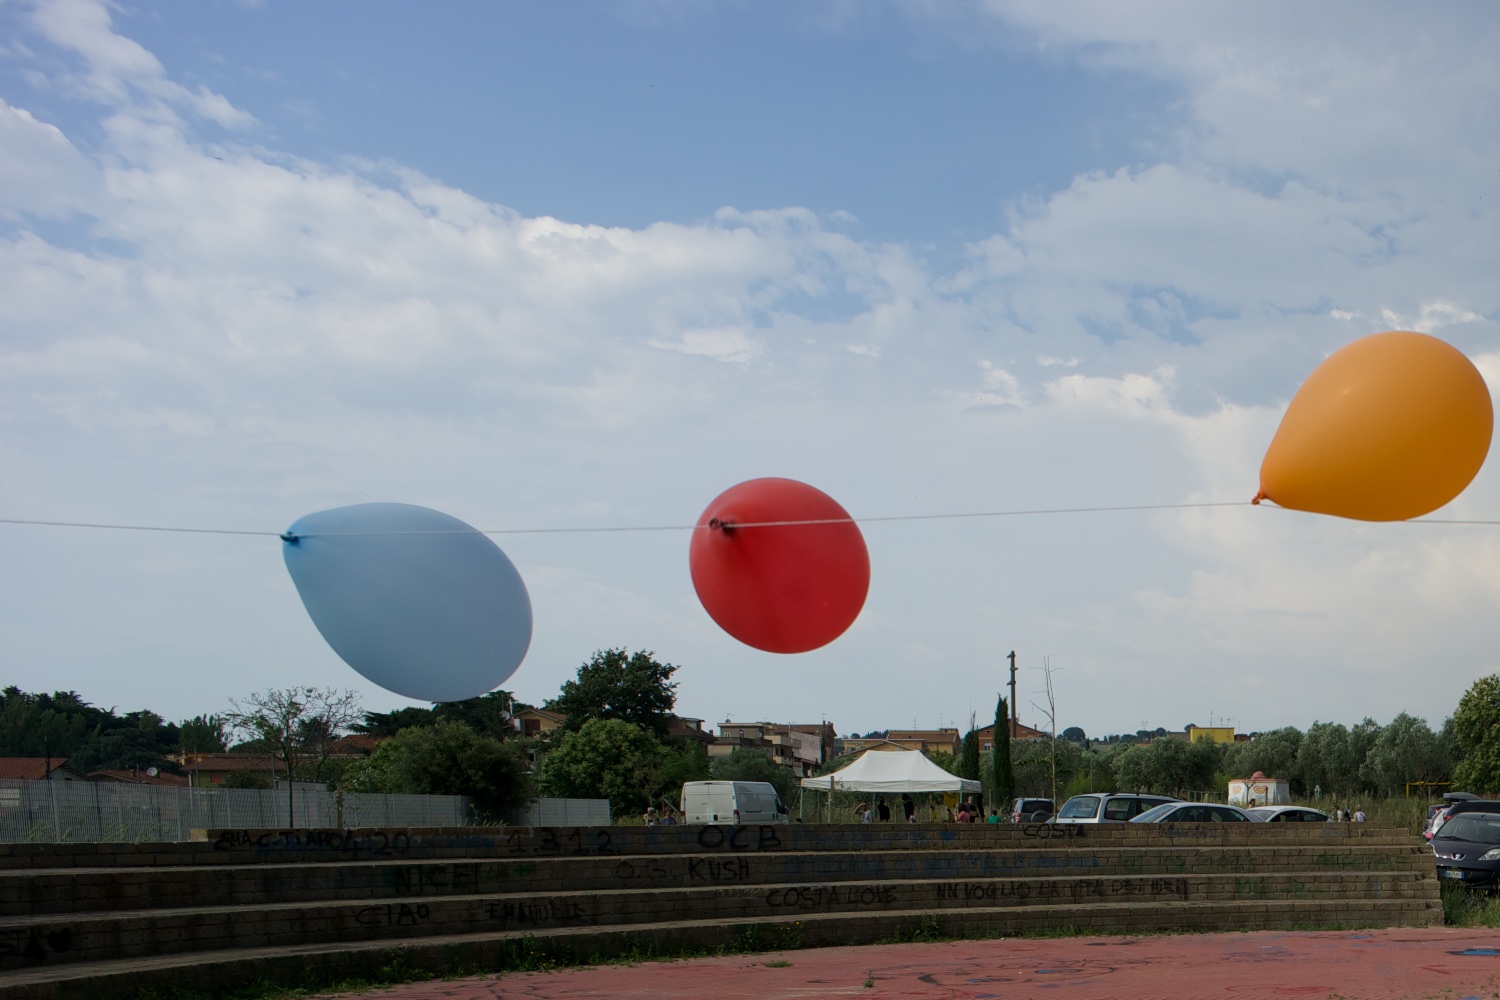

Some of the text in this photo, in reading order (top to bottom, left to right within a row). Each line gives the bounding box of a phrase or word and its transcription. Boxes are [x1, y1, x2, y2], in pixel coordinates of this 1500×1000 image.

[698, 825, 781, 852] OCB
[1023, 824, 1086, 839] COSTA
[688, 857, 750, 882] KUSH
[766, 886, 898, 910] COSTA LOVE
[964, 881, 1031, 900] VOGLIO
[354, 902, 430, 926] CIAO
